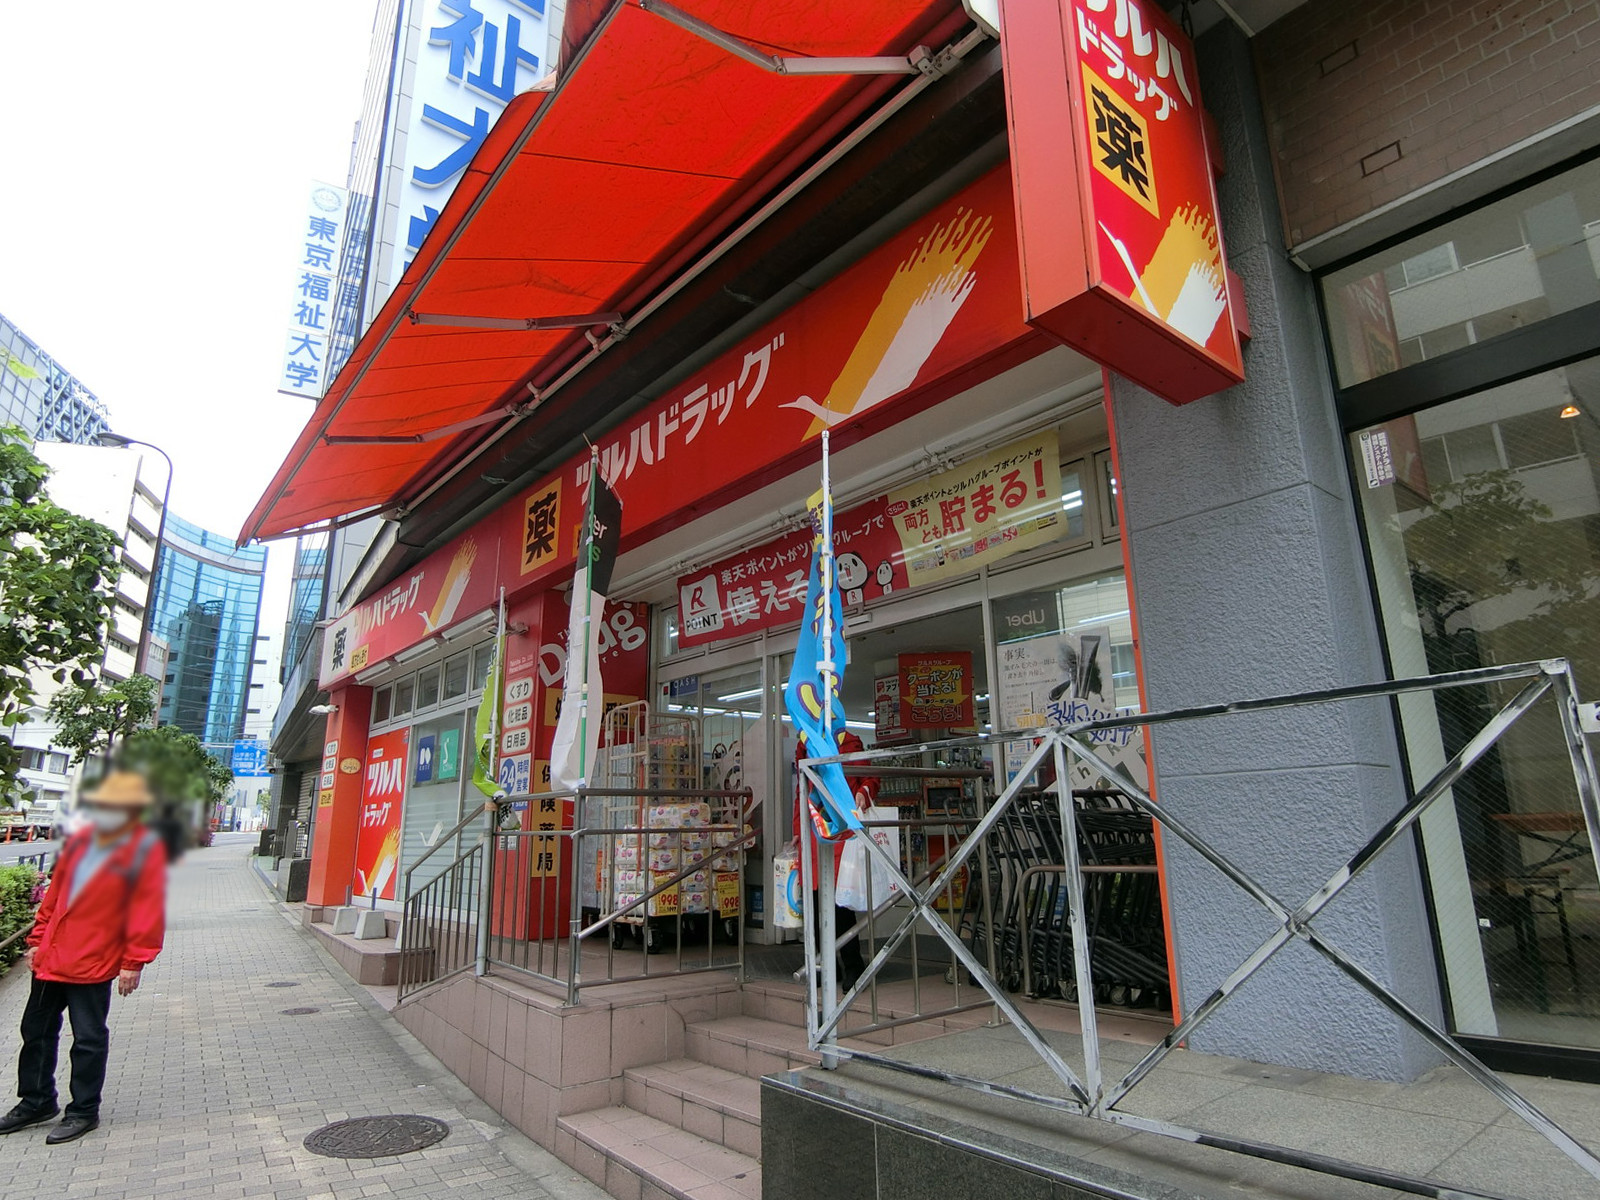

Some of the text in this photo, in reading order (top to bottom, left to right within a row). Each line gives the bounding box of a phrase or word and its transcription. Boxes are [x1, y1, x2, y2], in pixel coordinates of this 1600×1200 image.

[1076, 6, 1178, 121] ドラッグ
[1086, 0, 1193, 107] ルハ
[1091, 83, 1152, 203] 薬
[285, 215, 339, 391] 東京福祉大学
[575, 332, 785, 506] ツルハドラッグ
[909, 446, 1044, 509] 楽天ポイントとツルハグループポイントが
[526, 491, 558, 565] 薬
[903, 508, 930, 532] 両方
[922, 525, 943, 545] とも
[726, 568, 809, 627] 使える
[686, 613, 718, 633] POINT
[331, 627, 348, 672] 薬
[509, 681, 529, 699] くすり
[907, 667, 964, 686] クーポンが
[368, 758, 402, 797] ツルハ
[501, 766, 515, 788] 24
[661, 893, 679, 906] 998
